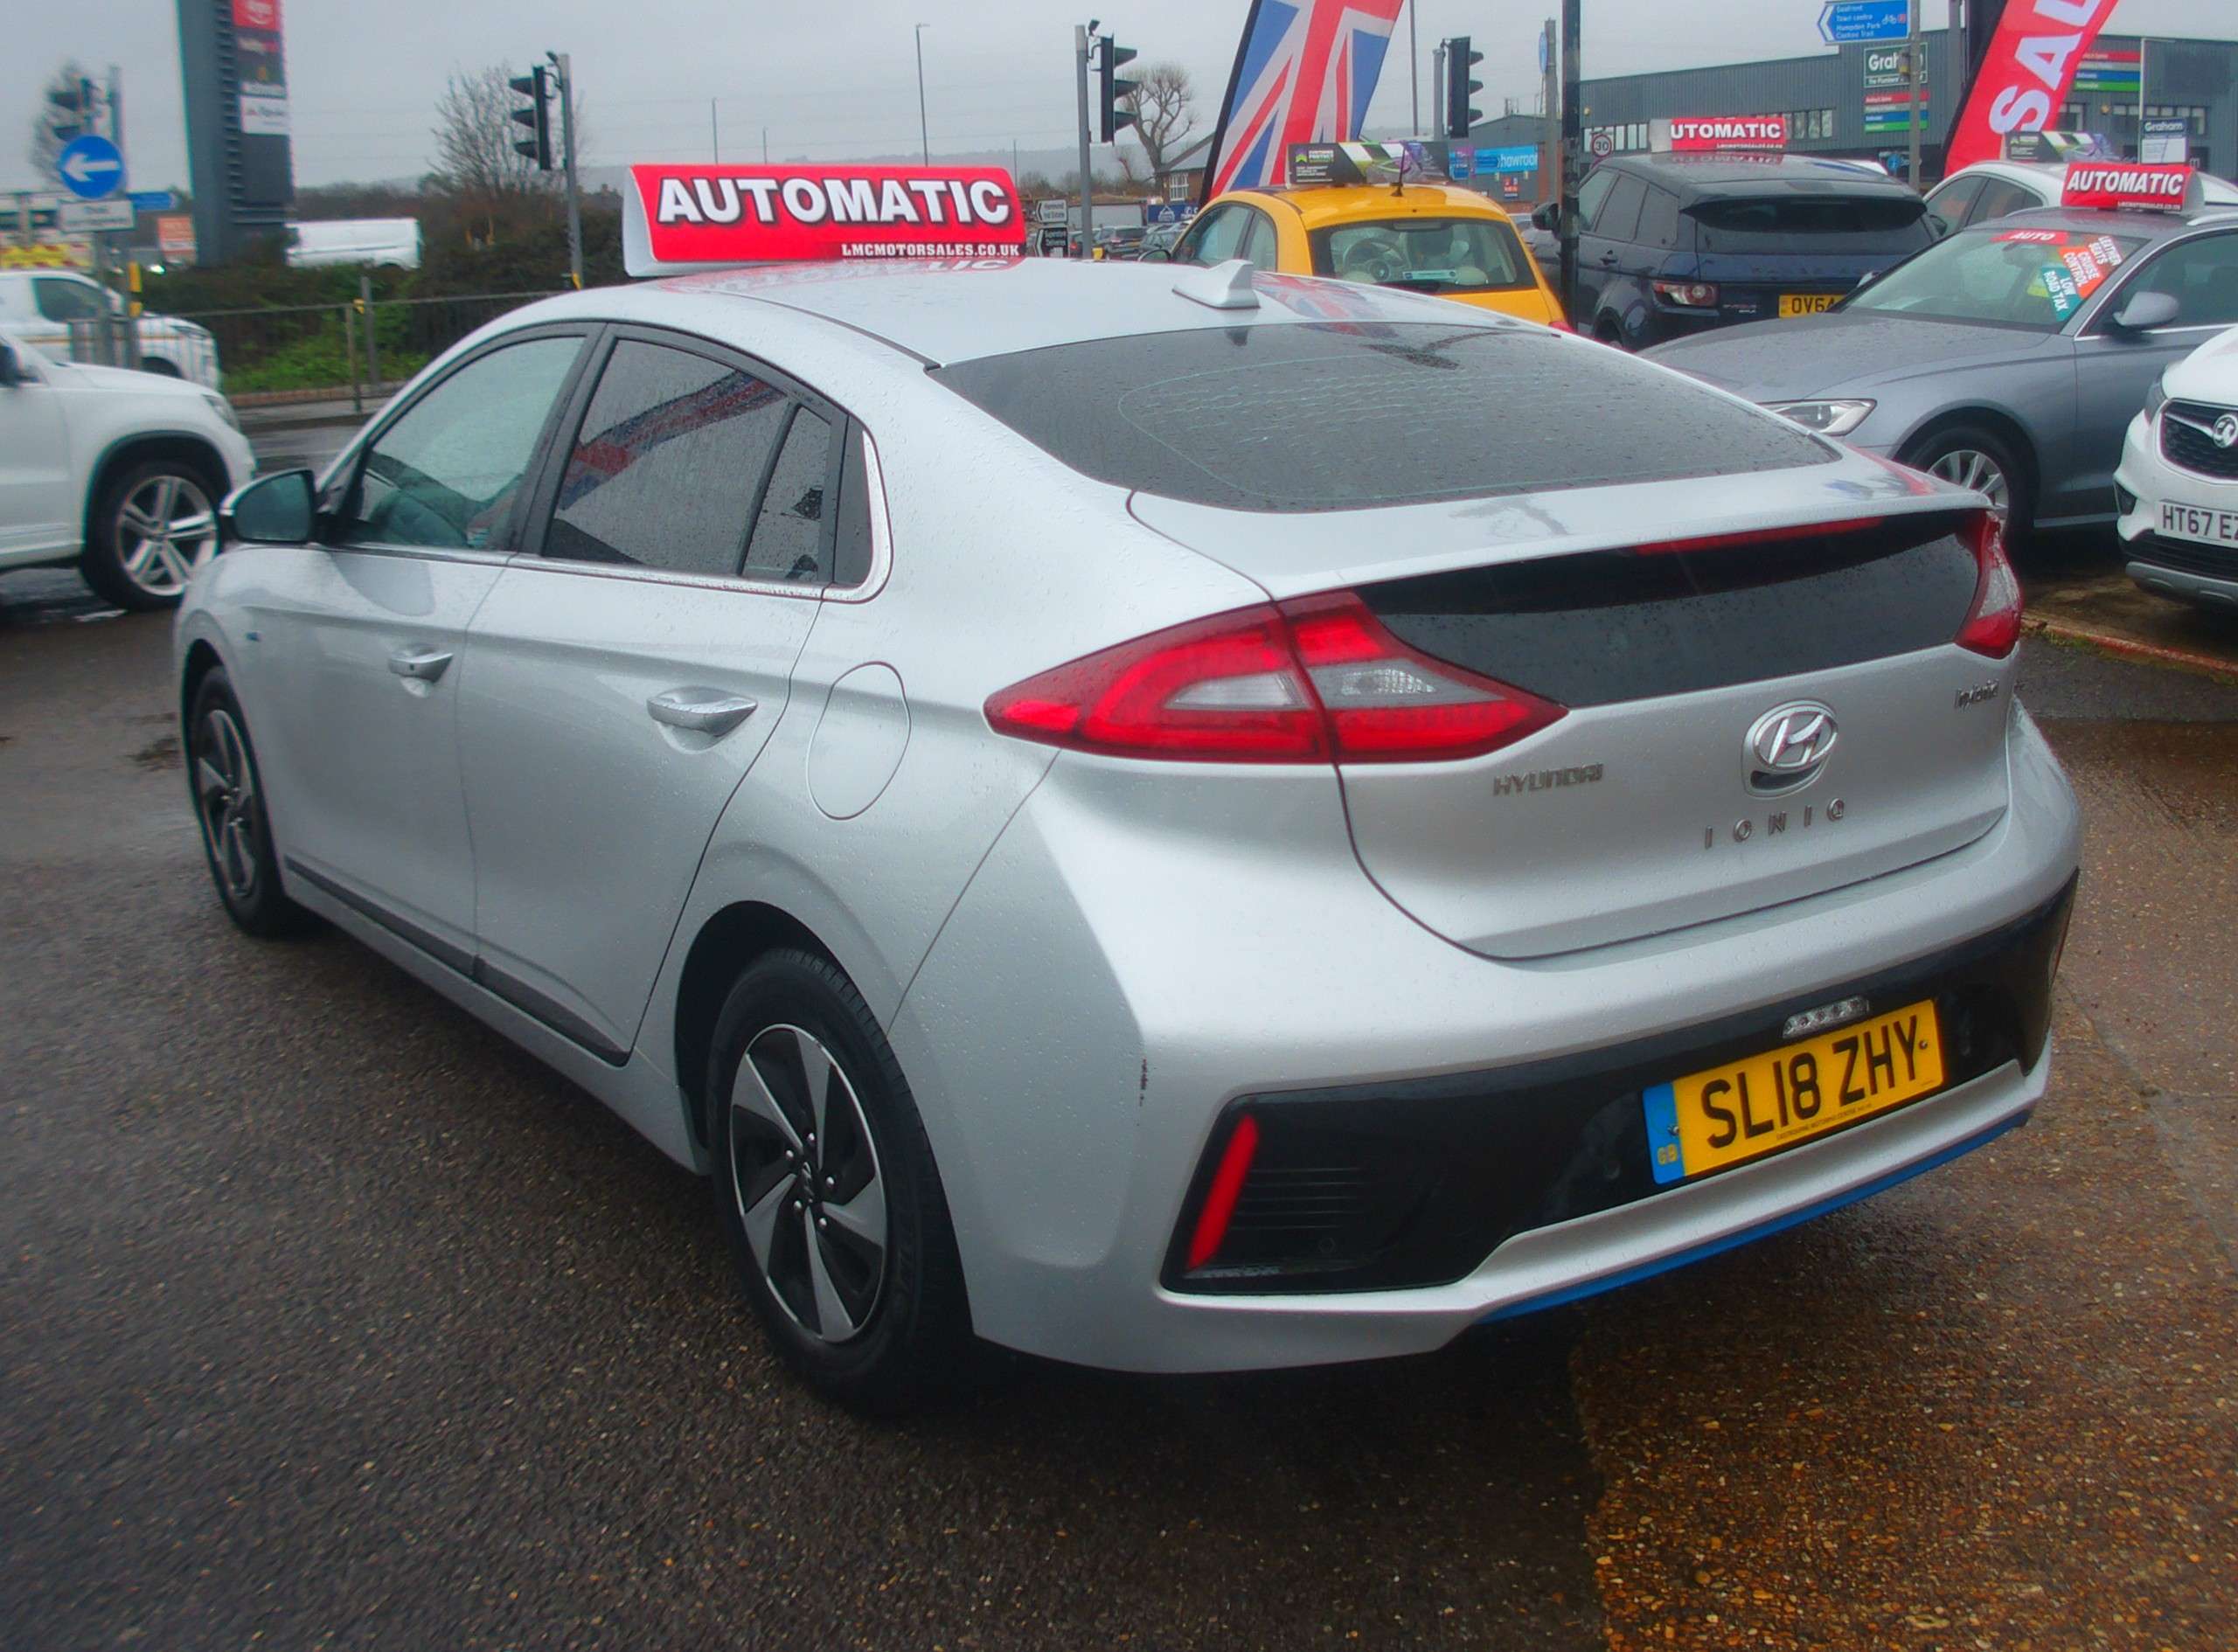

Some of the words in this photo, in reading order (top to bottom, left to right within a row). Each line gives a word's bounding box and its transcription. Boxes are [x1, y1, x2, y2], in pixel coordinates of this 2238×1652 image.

[2144, 121, 2183, 132] Graham
[1595, 142, 1609, 151] 30
[2067, 170, 2183, 196] AUTOMATIC
[658, 178, 1010, 224] AUTOMATIC
[2010, 232, 2056, 240] AUTO
[841, 243, 1019, 257] LMCMOTORSALES.CO.UK
[2063, 252, 2089, 287] CONTROL
[2077, 251, 2100, 280] CRUISE
[2044, 270, 2061, 293] ROAD
[2060, 277, 2077, 295] LOW
[2052, 291, 2068, 311] TAX
[2163, 504, 2213, 536] HT67
[1493, 763, 1603, 796] HYUNDAI
[1705, 797, 1845, 850] IONIQ
[1700, 1052, 1821, 1149] SL18
[1831, 1015, 1918, 1107] ZHY
[1657, 1143, 1678, 1165] GB
